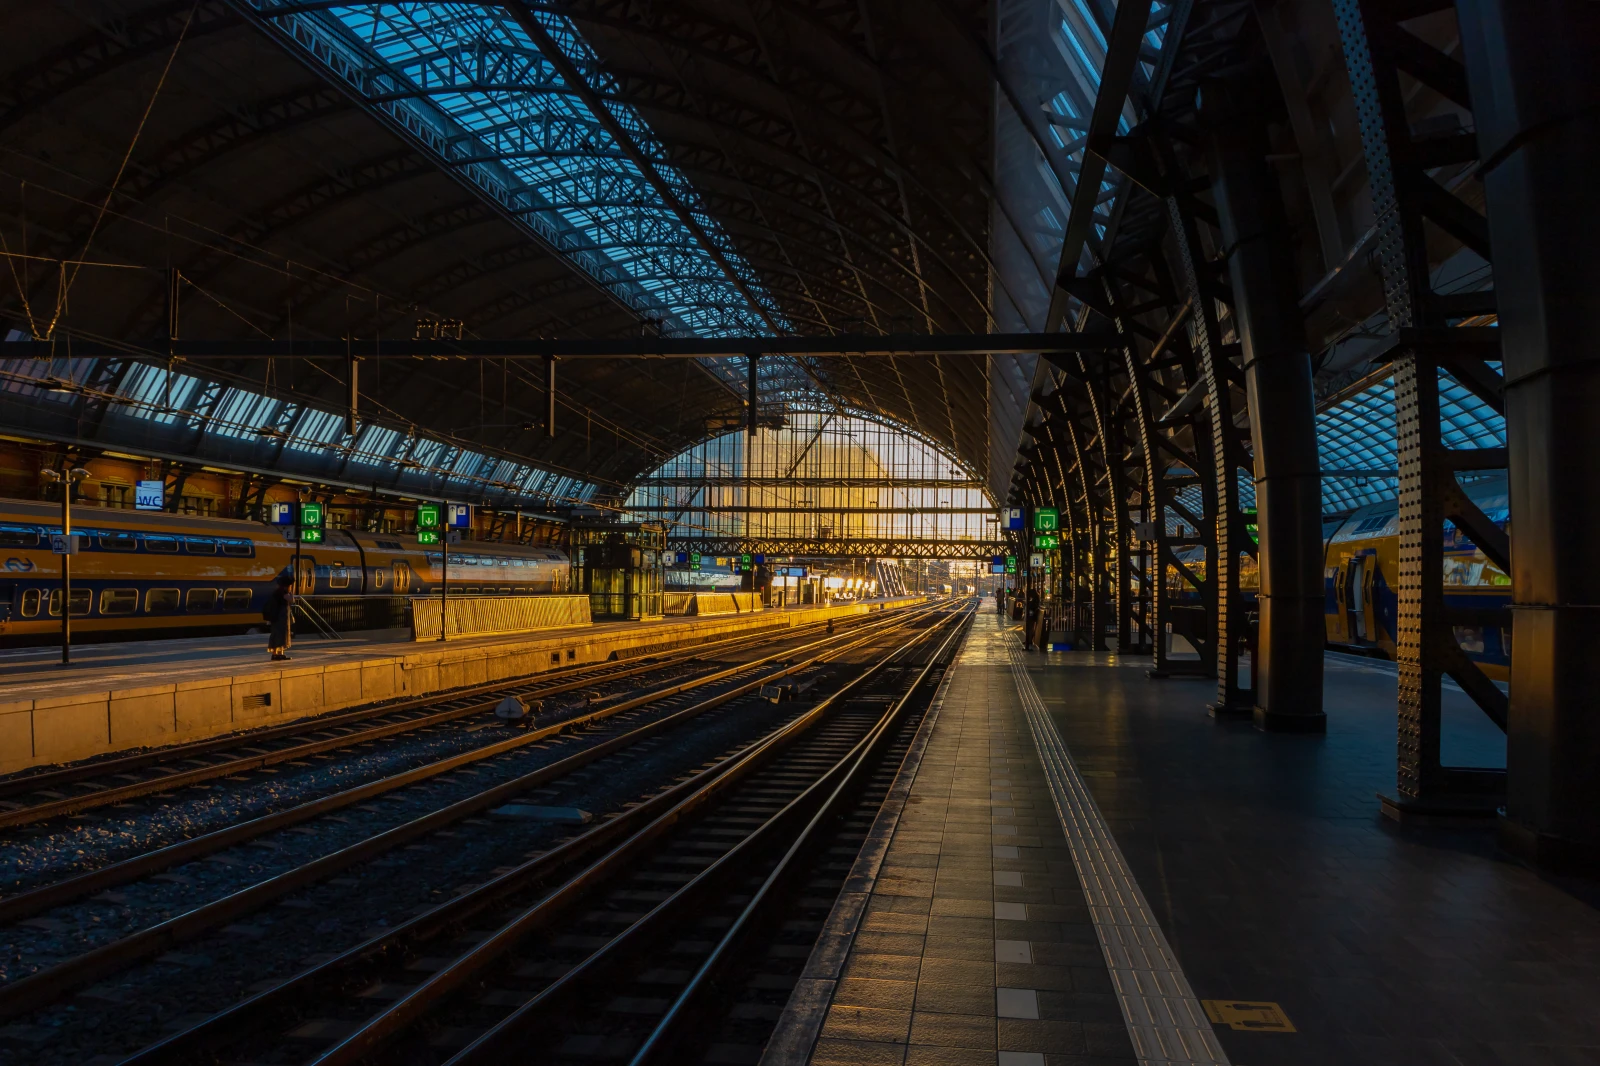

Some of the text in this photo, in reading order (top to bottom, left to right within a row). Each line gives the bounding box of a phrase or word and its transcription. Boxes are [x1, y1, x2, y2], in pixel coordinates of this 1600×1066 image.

[138, 496, 161, 507] WC
[38, 526, 47, 538] 2
[452, 535, 457, 543] F
[42, 588, 50, 600] 2
[218, 588, 224, 598] 2
